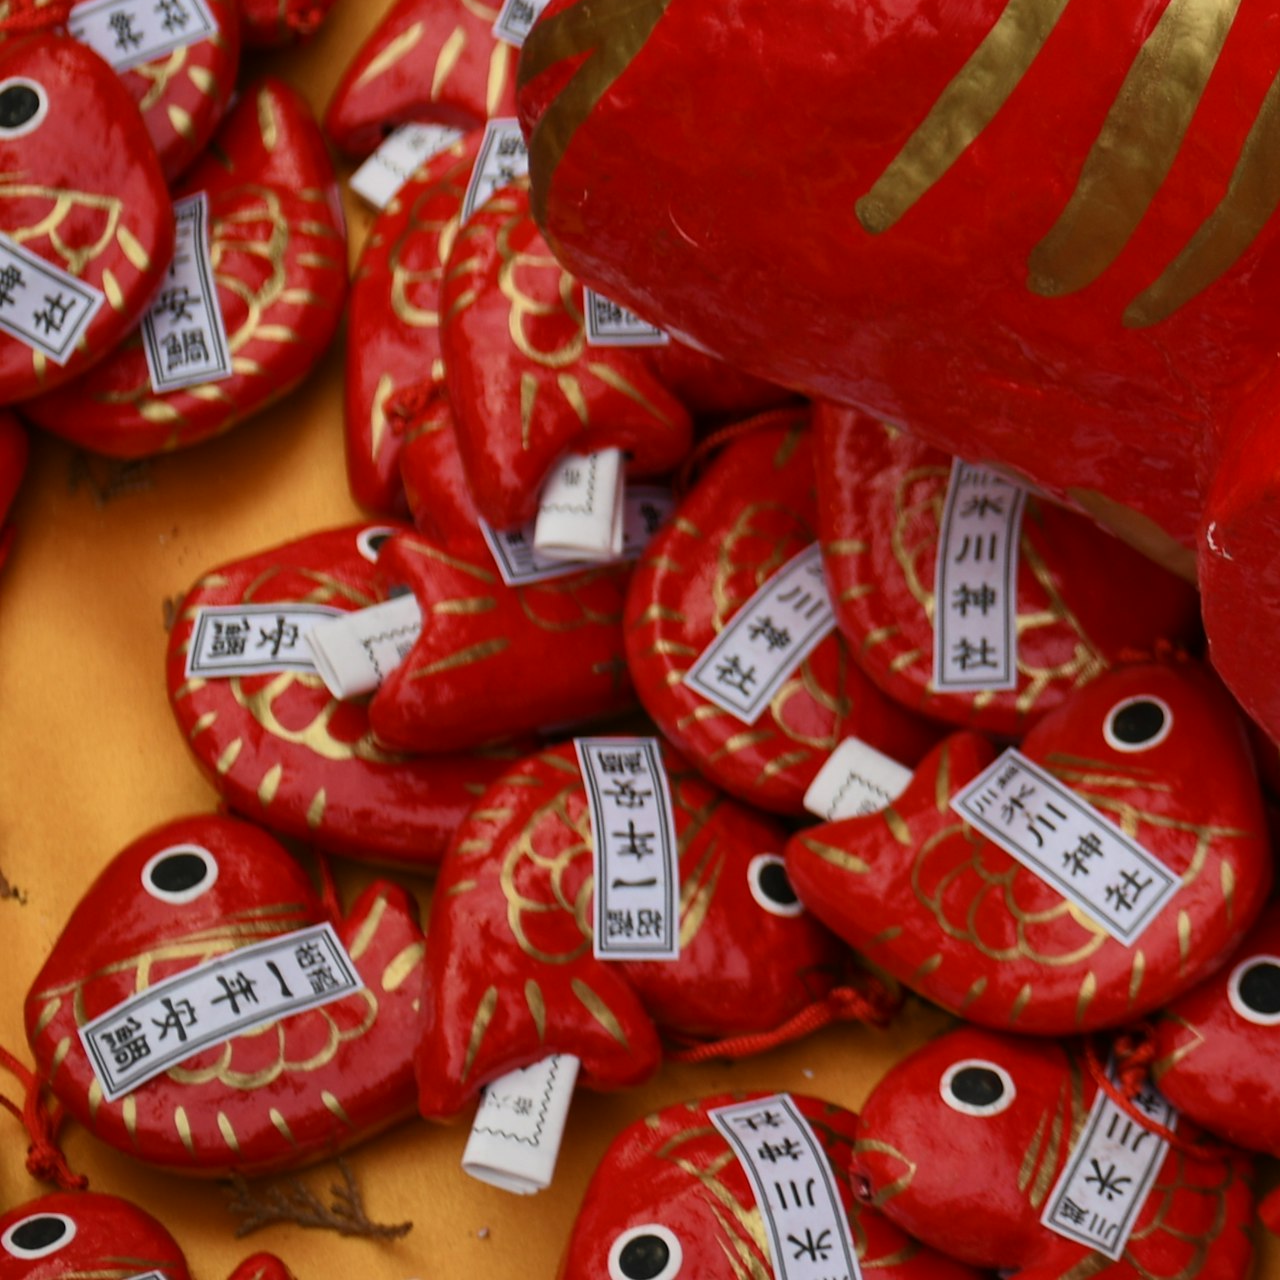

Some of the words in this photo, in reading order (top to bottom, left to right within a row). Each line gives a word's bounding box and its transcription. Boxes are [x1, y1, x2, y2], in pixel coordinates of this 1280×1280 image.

[971, 762, 1154, 912] 川越氷川神社
